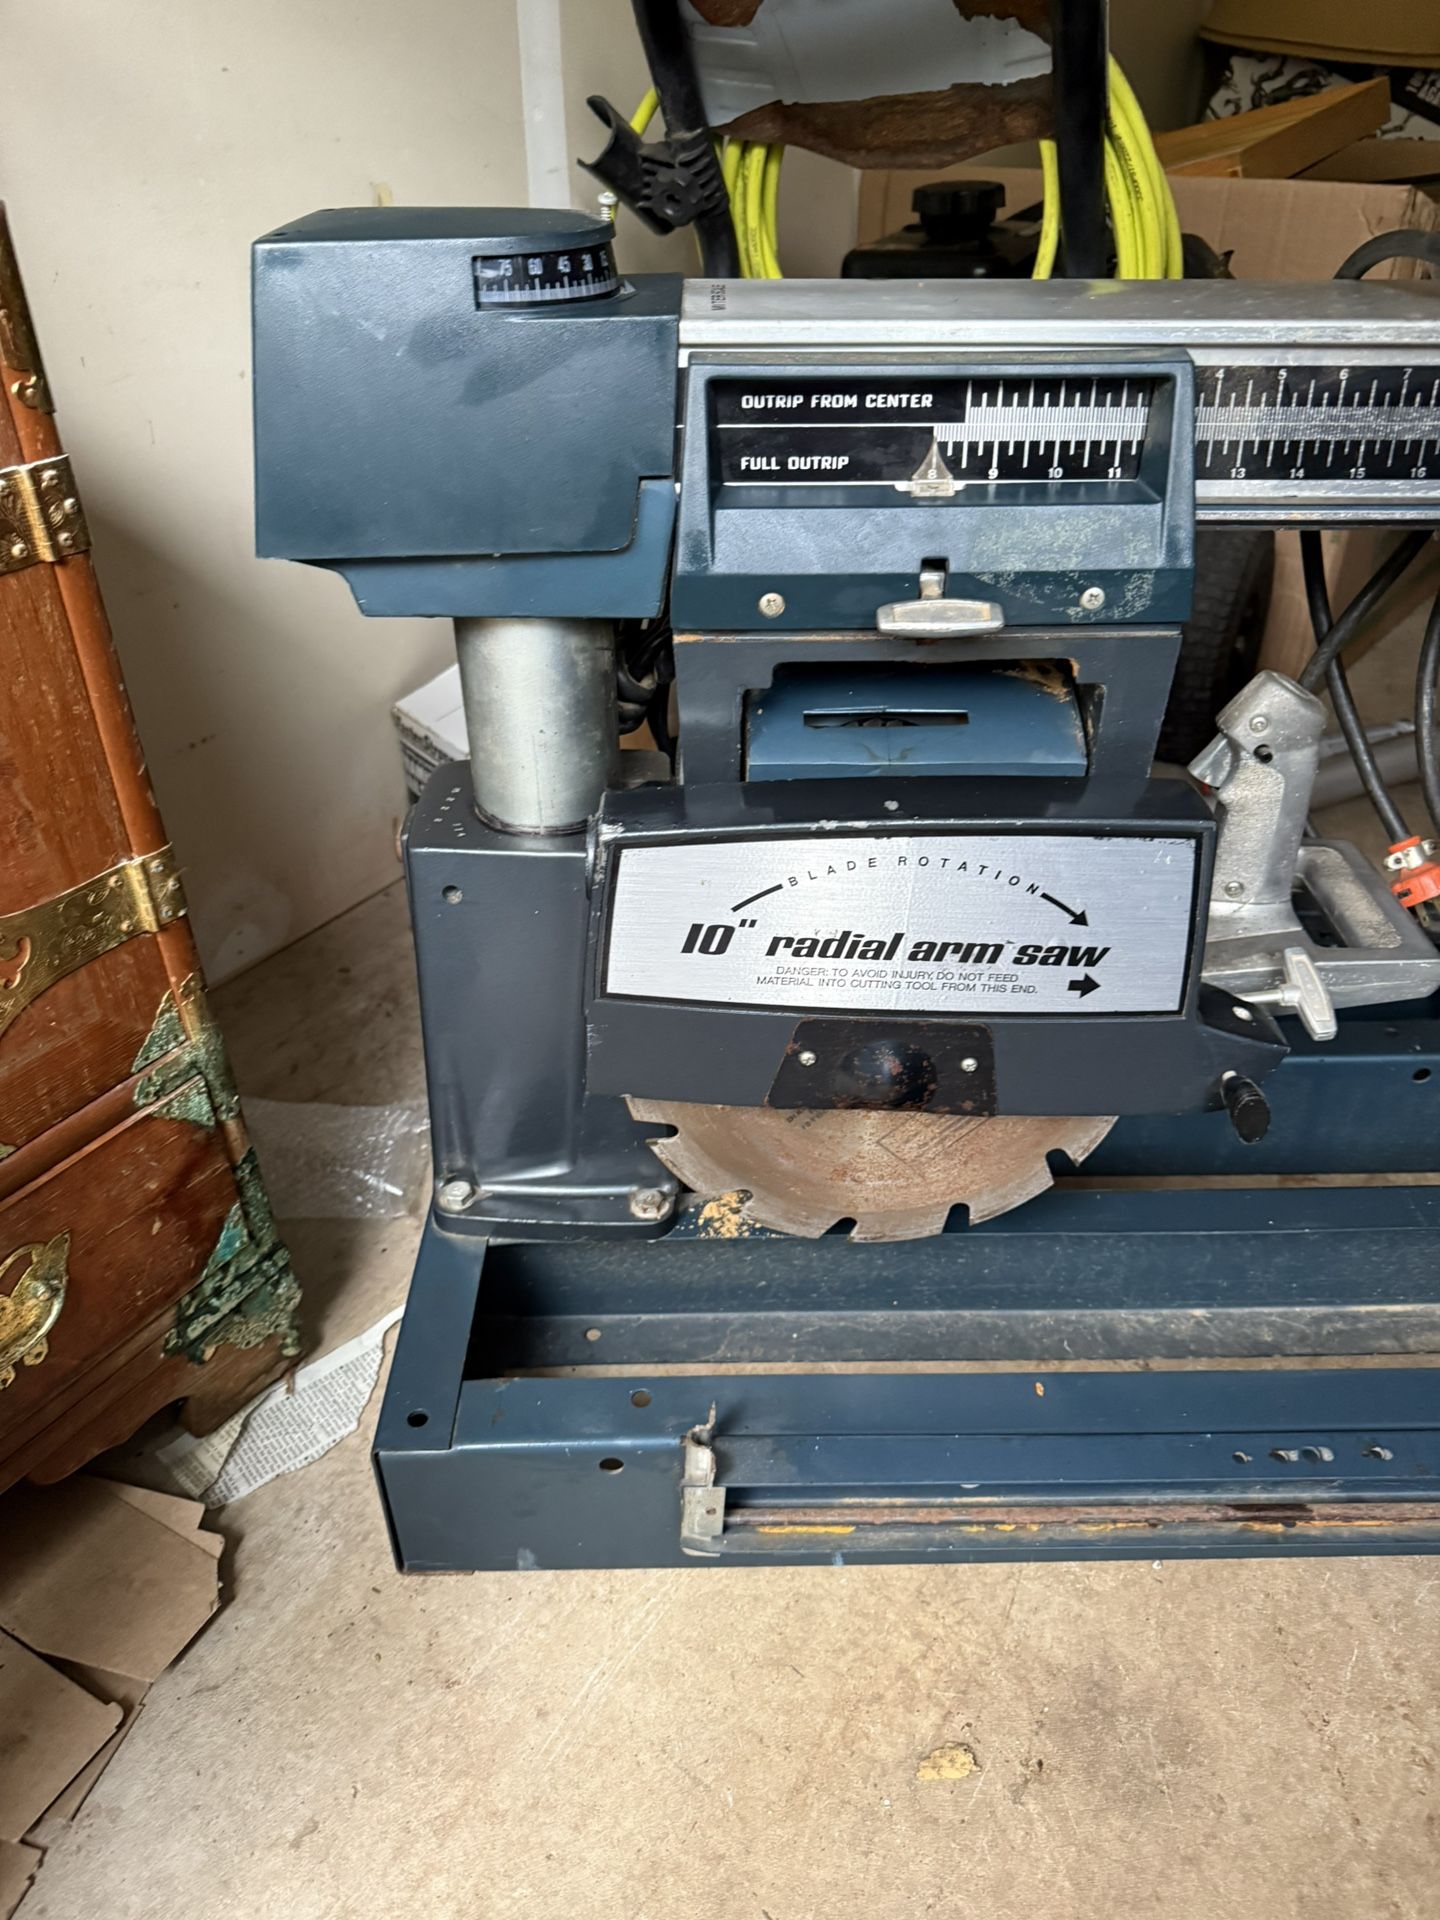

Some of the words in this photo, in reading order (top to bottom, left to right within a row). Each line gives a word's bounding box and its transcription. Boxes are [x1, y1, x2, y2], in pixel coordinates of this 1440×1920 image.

[1215, 368, 1225, 379] 4
[1277, 368, 1287, 379] 5
[1339, 368, 1349, 379] 6
[1403, 368, 1412, 379] 7
[741, 395, 804, 409] OUTRIP
[810, 394, 858, 408] FROM
[865, 393, 933, 408] CENTER
[741, 456, 780, 470] FULL
[787, 456, 850, 470] OUTRIP
[928, 469, 937, 479] 8
[988, 468, 999, 479] 9
[1048, 467, 1064, 479] 10
[1107, 467, 1122, 479] 11
[1230, 467, 1246, 479] 13
[1289, 467, 1305, 479] 14
[1349, 467, 1366, 479] 15
[1410, 466, 1427, 478] 16
[788, 857, 878, 887] BLADE
[897, 856, 1040, 895] ROTATION
[680, 918, 758, 956] 10"
[765, 930, 905, 961] radial
[907, 941, 1005, 964] arm
[1012, 944, 1111, 967] saw
[776, 966, 829, 976] DANGER:
[832, 968, 848, 977] TO
[852, 968, 888, 979] AVOID
[891, 969, 933, 981] INJURY,
[936, 971, 954, 981] DO
[958, 972, 984, 982] NOT
[987, 973, 1019, 983] FEED
[756, 976, 814, 986] MATERIAL
[818, 978, 847, 987] INTO
[850, 979, 901, 989] CUTTING
[905, 981, 937, 991] TOOL
[941, 982, 976, 992] FROM
[980, 983, 1007, 993] THIS
[1011, 984, 1038, 994] END.
